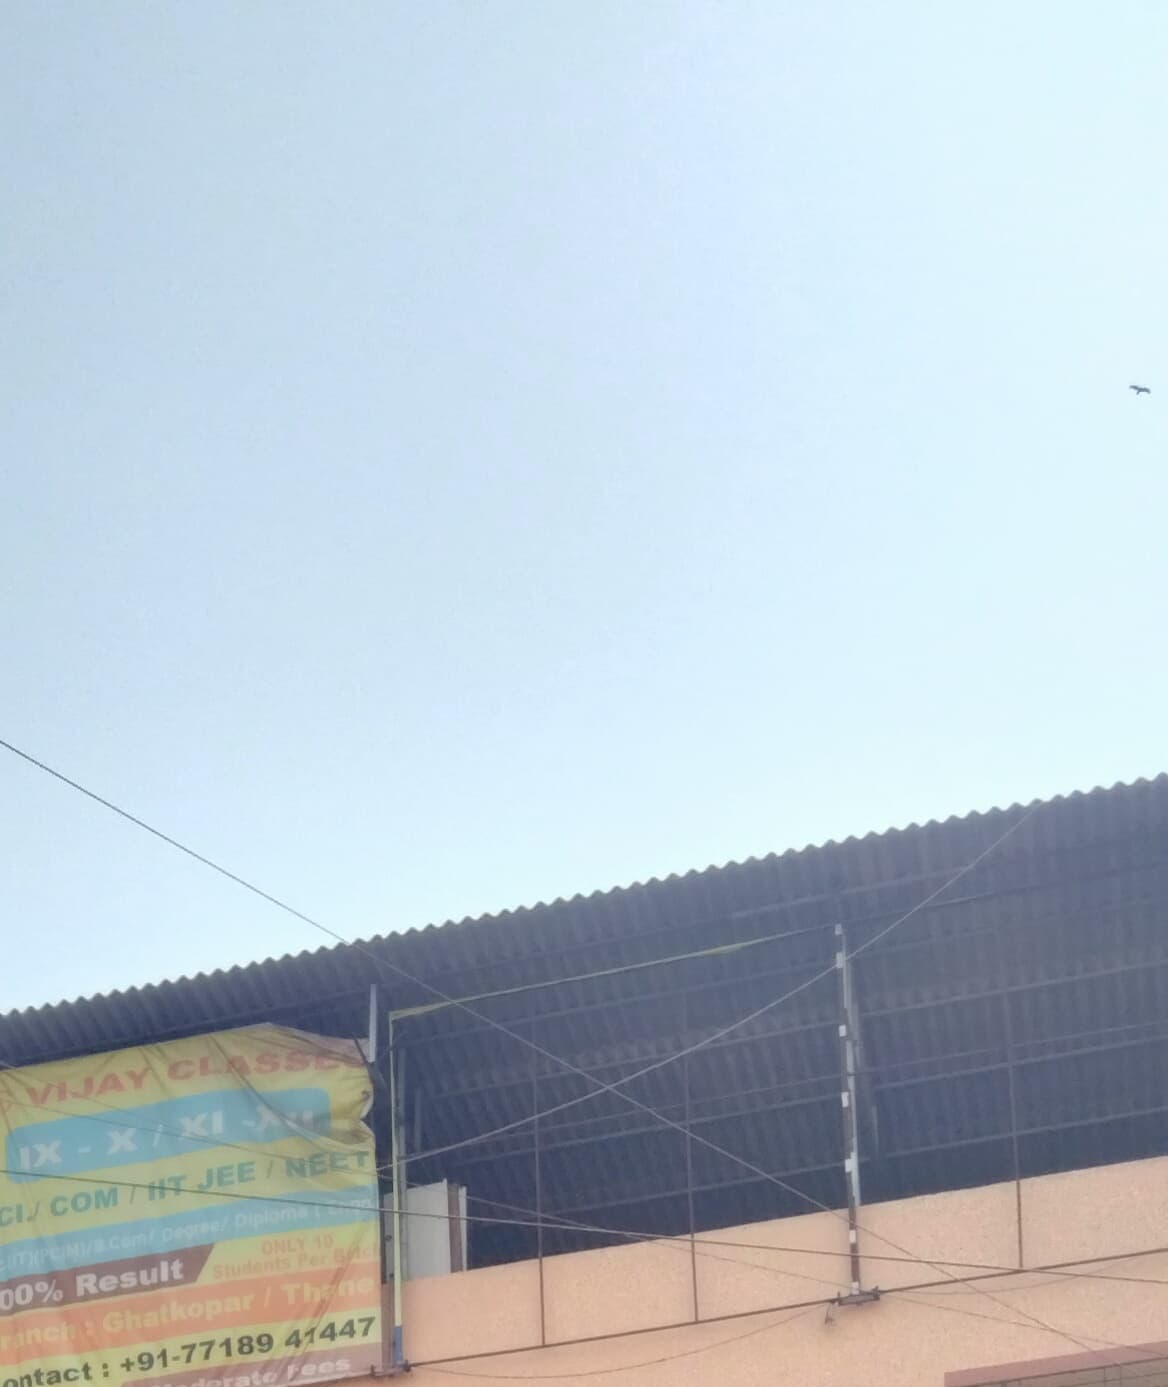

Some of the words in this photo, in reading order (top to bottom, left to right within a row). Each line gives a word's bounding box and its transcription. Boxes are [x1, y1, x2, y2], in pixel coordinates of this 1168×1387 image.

[25, 1066, 153, 1106] VIJAY
[19, 1139, 63, 1171] IX
[107, 1127, 138, 1155] X
[179, 1110, 224, 1137] XI
[50, 1187, 119, 1217] COM
[148, 1174, 186, 1201] IIT
[198, 1160, 256, 1191] JEE
[285, 1151, 370, 1179] NEET
[213, 1256, 291, 1280] Students
[298, 1252, 331, 1270] Per
[262, 1236, 305, 1256] ONLY
[75, 1257, 185, 1297] Result
[103, 1293, 256, 1333] Ghatkopar
[281, 1275, 376, 1305] Thane
[120, 1332, 274, 1373] +91-77189
[284, 1316, 377, 1349] 41447
